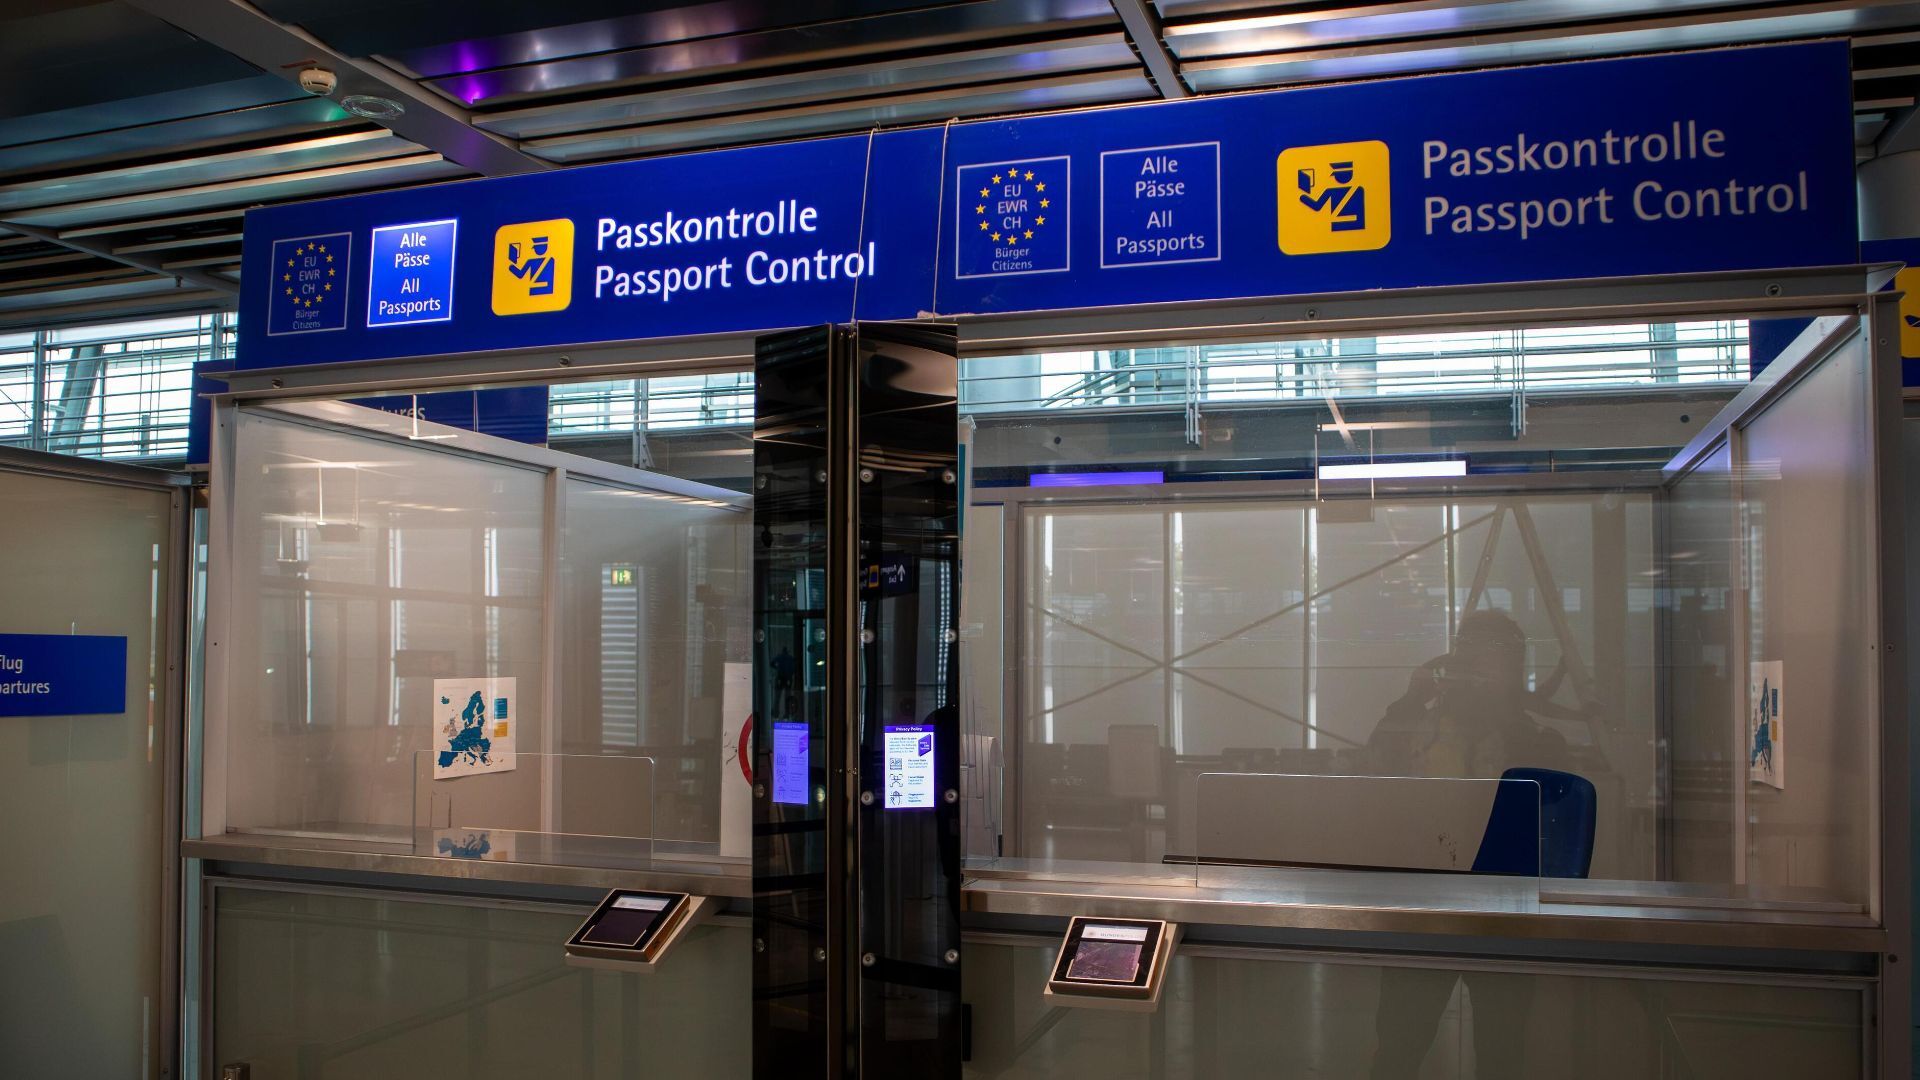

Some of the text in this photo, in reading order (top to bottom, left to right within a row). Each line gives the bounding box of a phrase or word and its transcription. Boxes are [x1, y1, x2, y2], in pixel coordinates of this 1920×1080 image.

[1423, 119, 1726, 179] Passkontrolle
[1141, 156, 1178, 175] Alle
[1003, 184, 1022, 198] EU
[1135, 180, 1185, 199] Pässe
[997, 199, 1028, 214] EWR
[1424, 171, 1808, 240] Passport Control
[597, 199, 818, 251] Passkontrolle
[1003, 216, 1022, 230] CH
[1146, 210, 1172, 229] All
[400, 232, 427, 249] Alle
[1116, 233, 1205, 256] Passports
[304, 256, 317, 267] EU
[394, 251, 430, 268] Pässe
[995, 246, 1030, 260] Bürger
[595, 241, 875, 302] Passport Control
[992, 259, 1033, 271] Citizens
[299, 269, 321, 281] EWR
[302, 283, 315, 295] CH
[401, 277, 420, 294] All
[295, 308, 320, 320] Bürger
[379, 296, 441, 316] Passports
[292, 319, 321, 330] Citizens
[0, 680, 50, 694] artures
